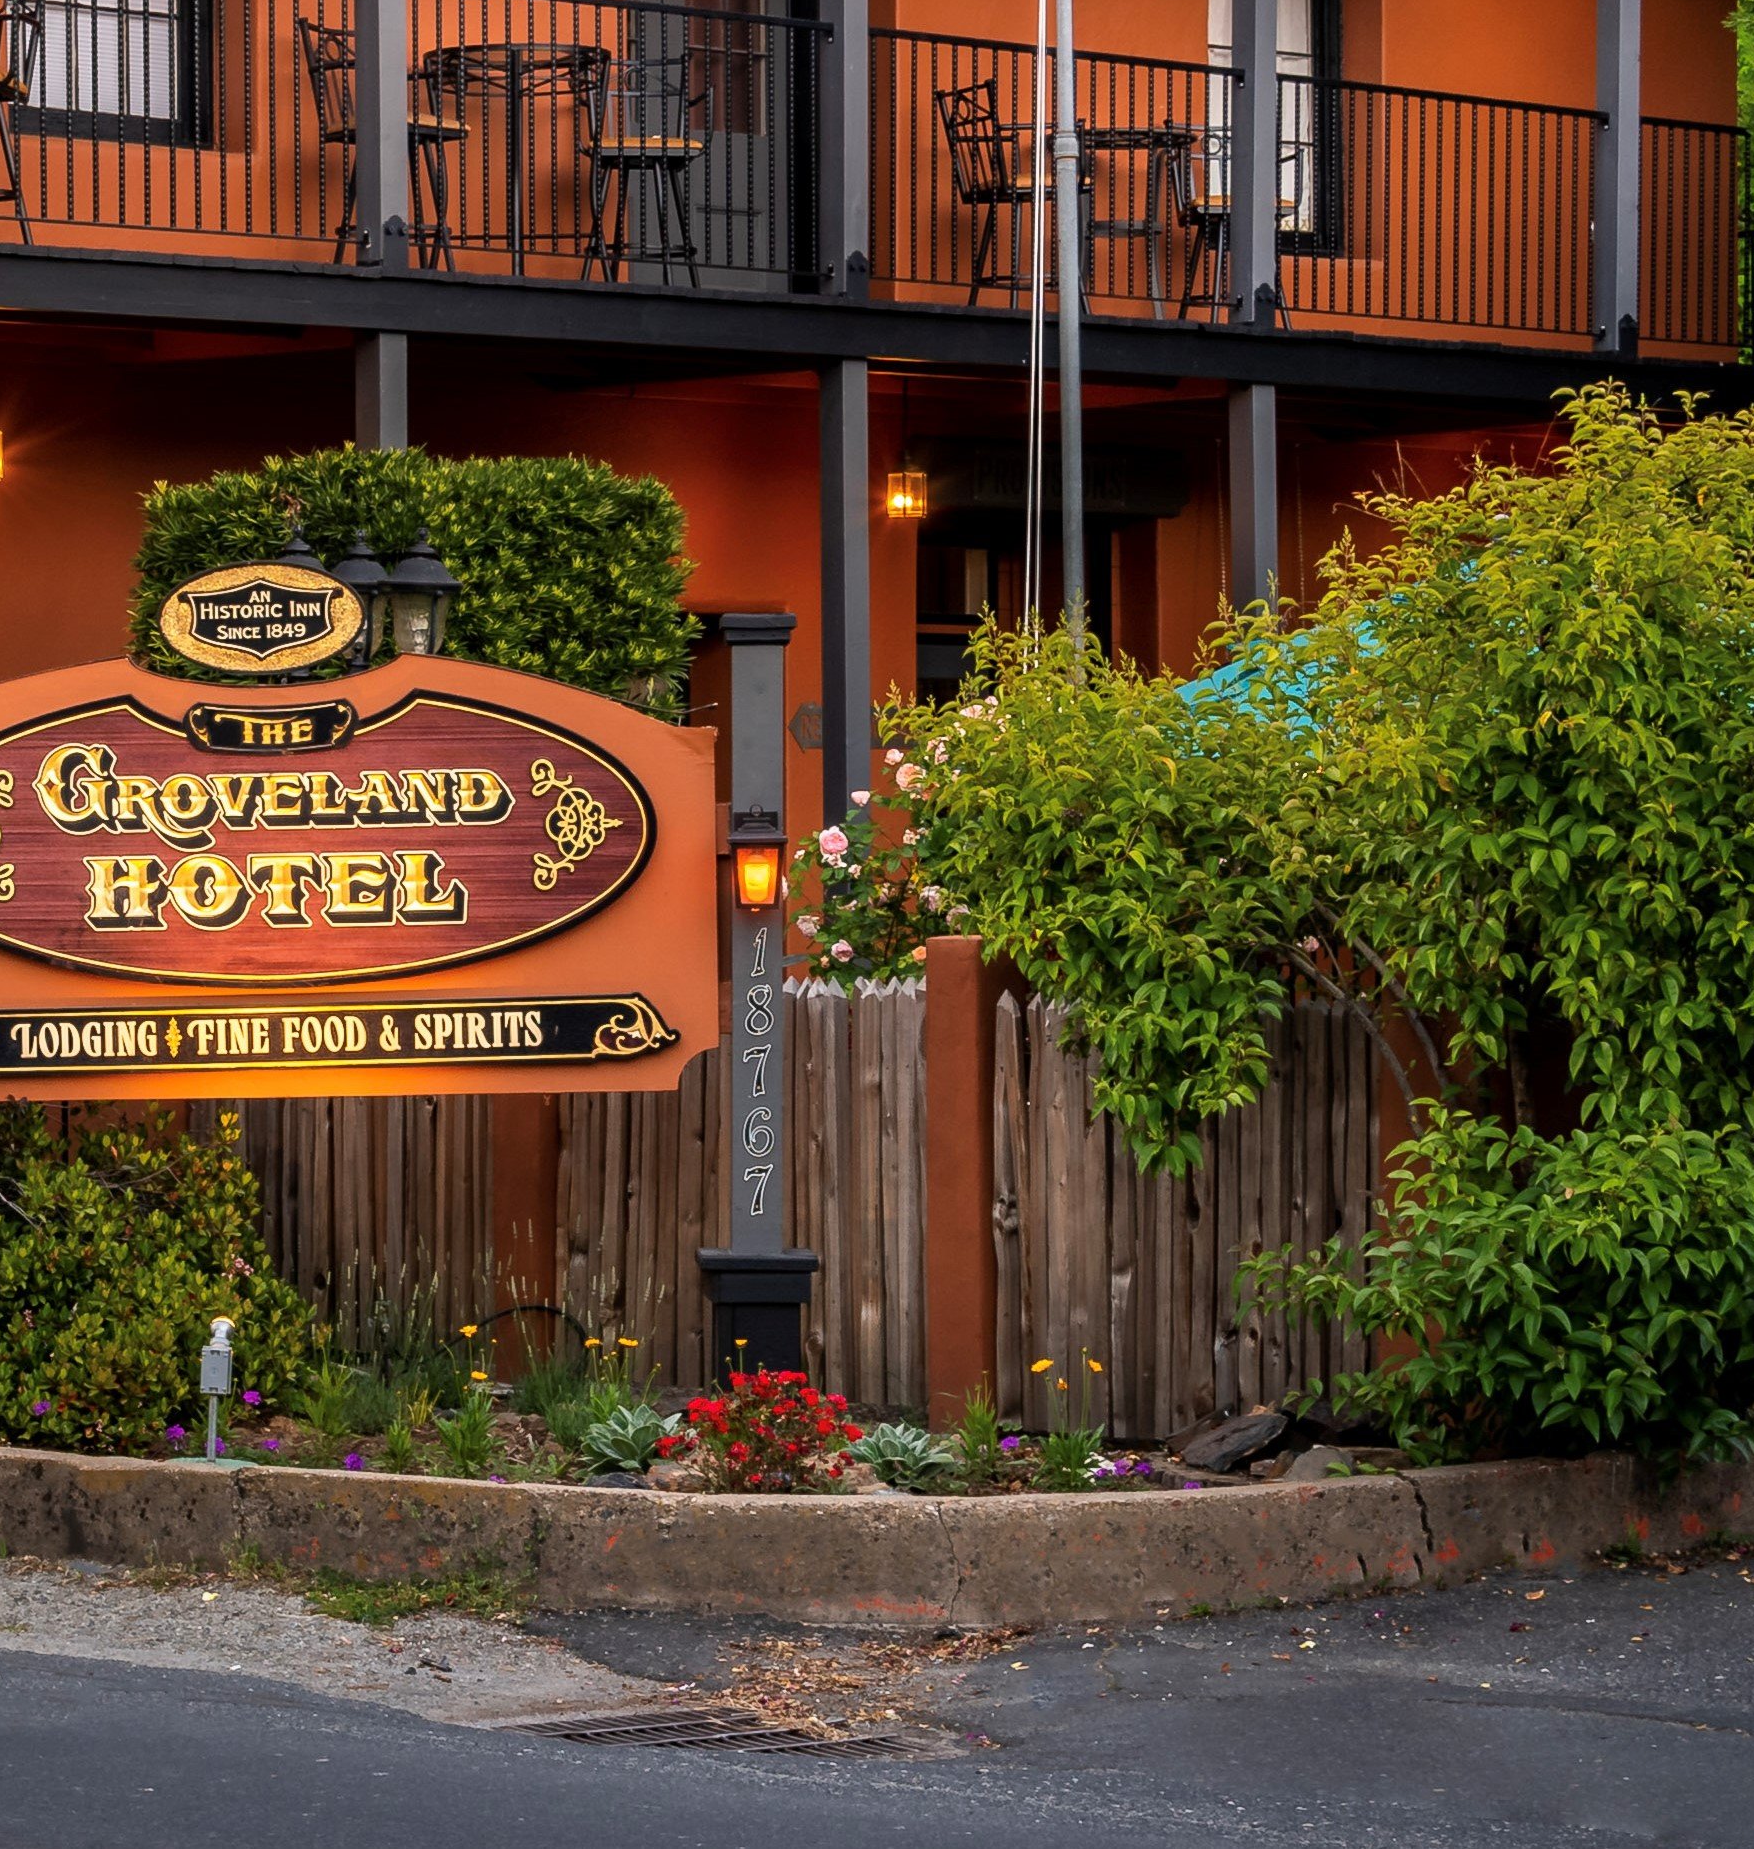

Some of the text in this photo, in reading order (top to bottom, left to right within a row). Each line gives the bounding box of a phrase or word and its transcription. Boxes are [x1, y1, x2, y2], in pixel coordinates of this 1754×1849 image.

[200, 601, 322, 620] HISTORIC INN
[248, 590, 271, 603] AN
[216, 623, 306, 640] SINCE 1849
[215, 714, 314, 745] THE
[34, 743, 516, 852] GROVELAND
[83, 850, 469, 932] HOTEL
[10, 1011, 544, 1058] LODGING FINE FOOD & SPIRITS
[741, 927, 776, 1217] 18767
